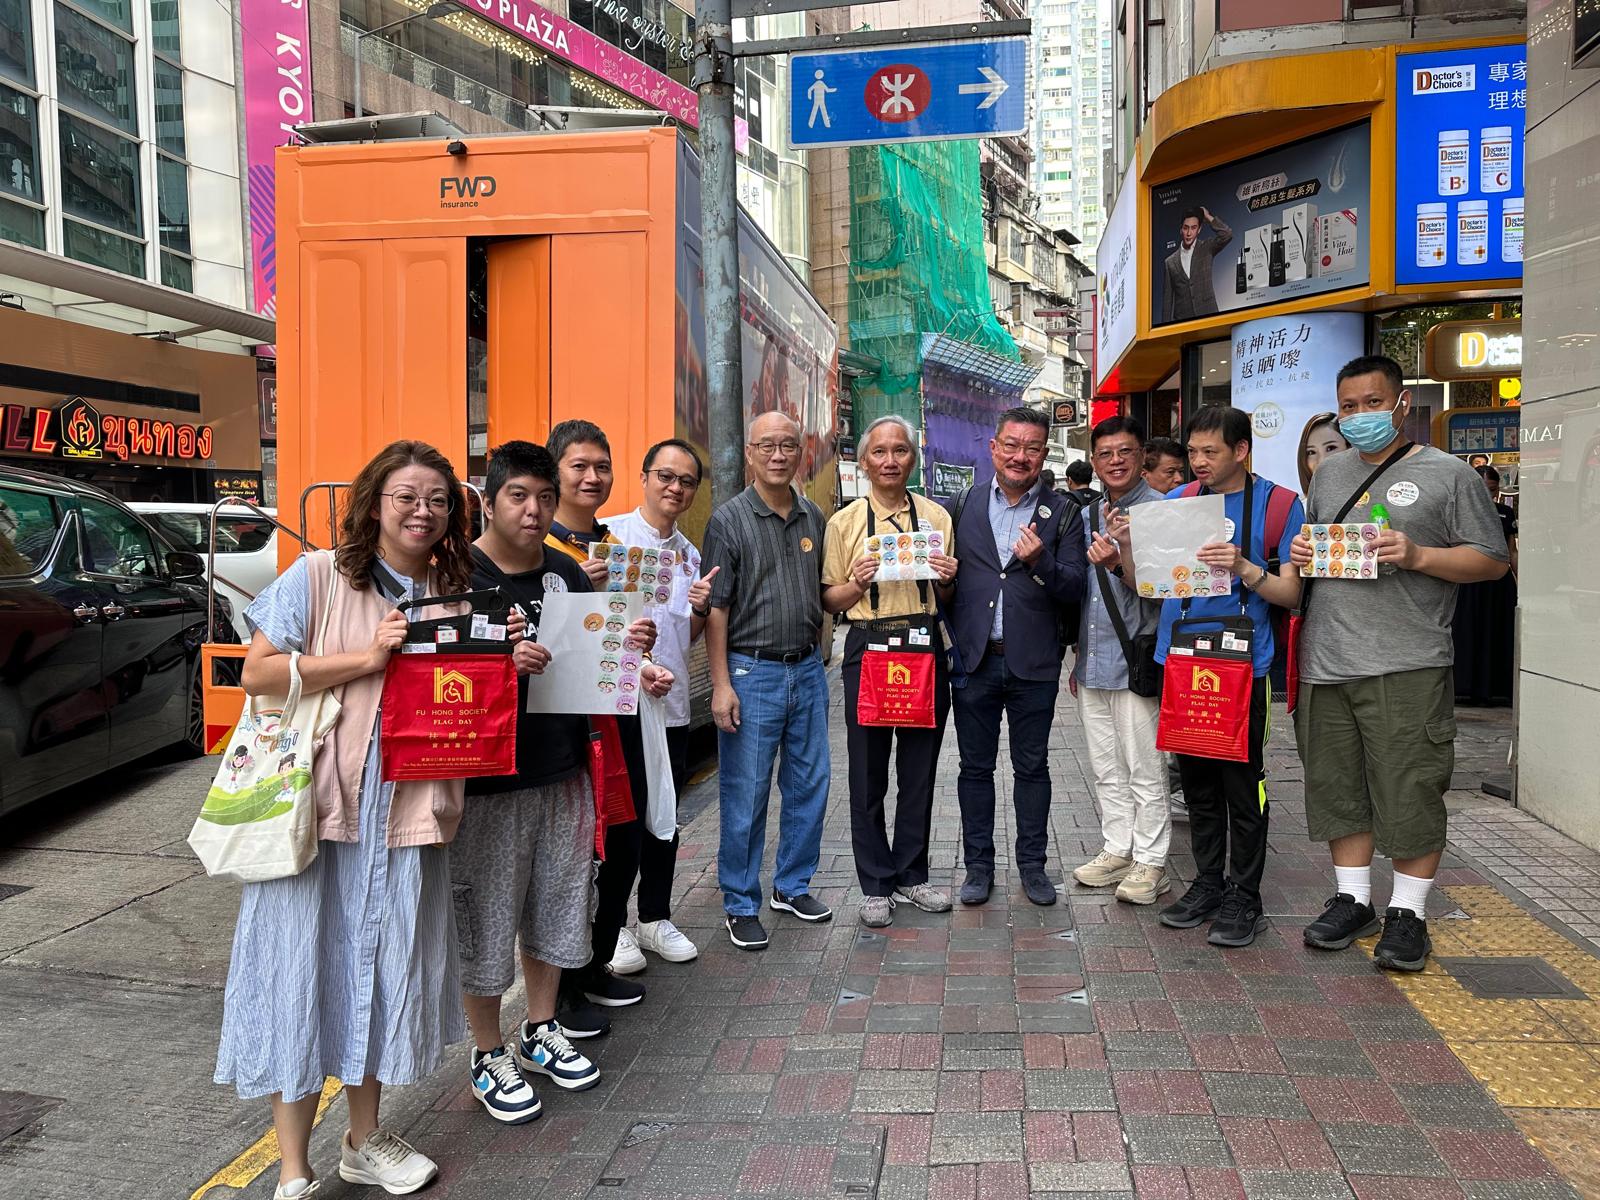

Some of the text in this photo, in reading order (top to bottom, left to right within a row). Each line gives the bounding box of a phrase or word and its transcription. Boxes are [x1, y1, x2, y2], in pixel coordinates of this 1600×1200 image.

[499, 0, 570, 54] PLAZA
[1417, 70, 1462, 91] Doctor's
[1433, 80, 1462, 90] Choice
[440, 176, 497, 198] FWD
[440, 200, 479, 208] insurance
[1236, 323, 1311, 359] 精神活力
[0, 404, 57, 453] LL
[102, 415, 213, 461] ขุนทอง
[459, 708, 488, 716] SOCIETY
